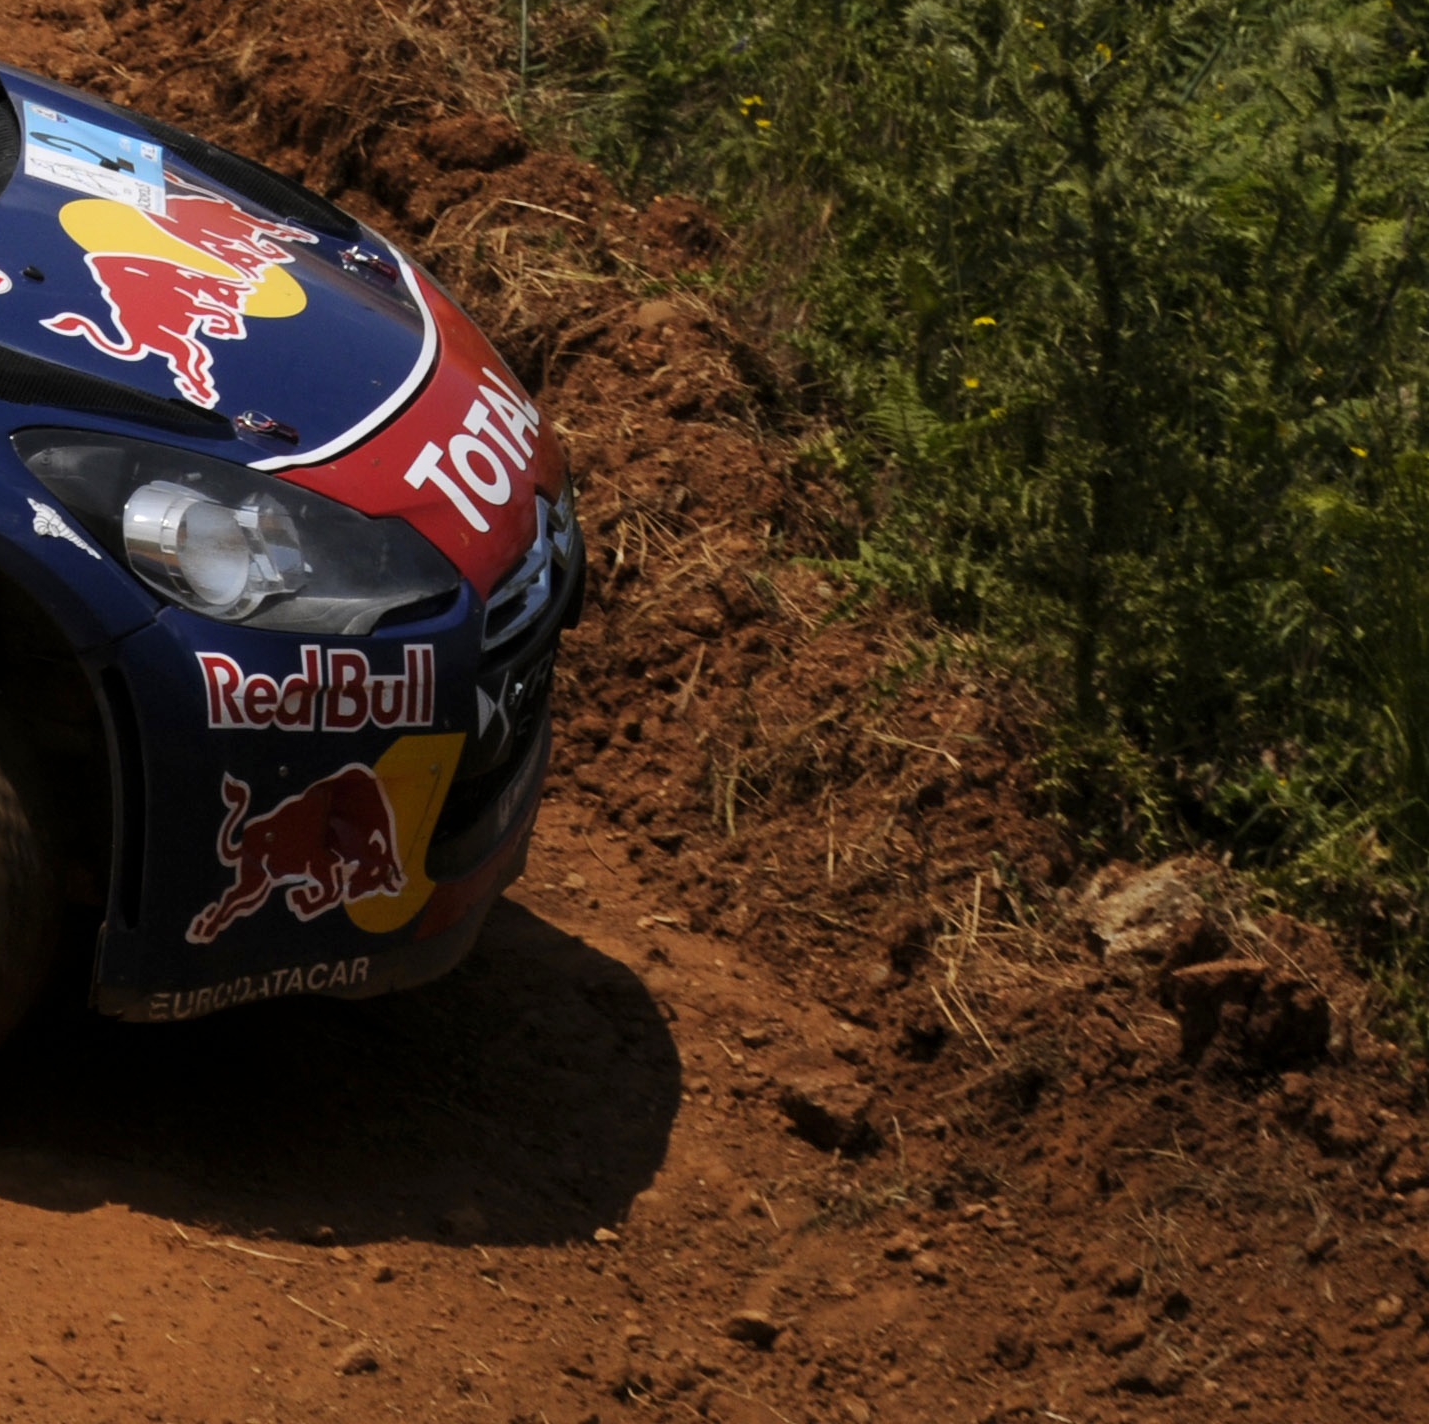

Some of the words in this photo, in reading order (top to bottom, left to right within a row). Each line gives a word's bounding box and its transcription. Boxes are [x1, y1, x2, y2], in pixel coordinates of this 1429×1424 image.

[403, 366, 540, 534] TOTAL
[196, 644, 321, 732] Red
[322, 643, 435, 733] Bull
